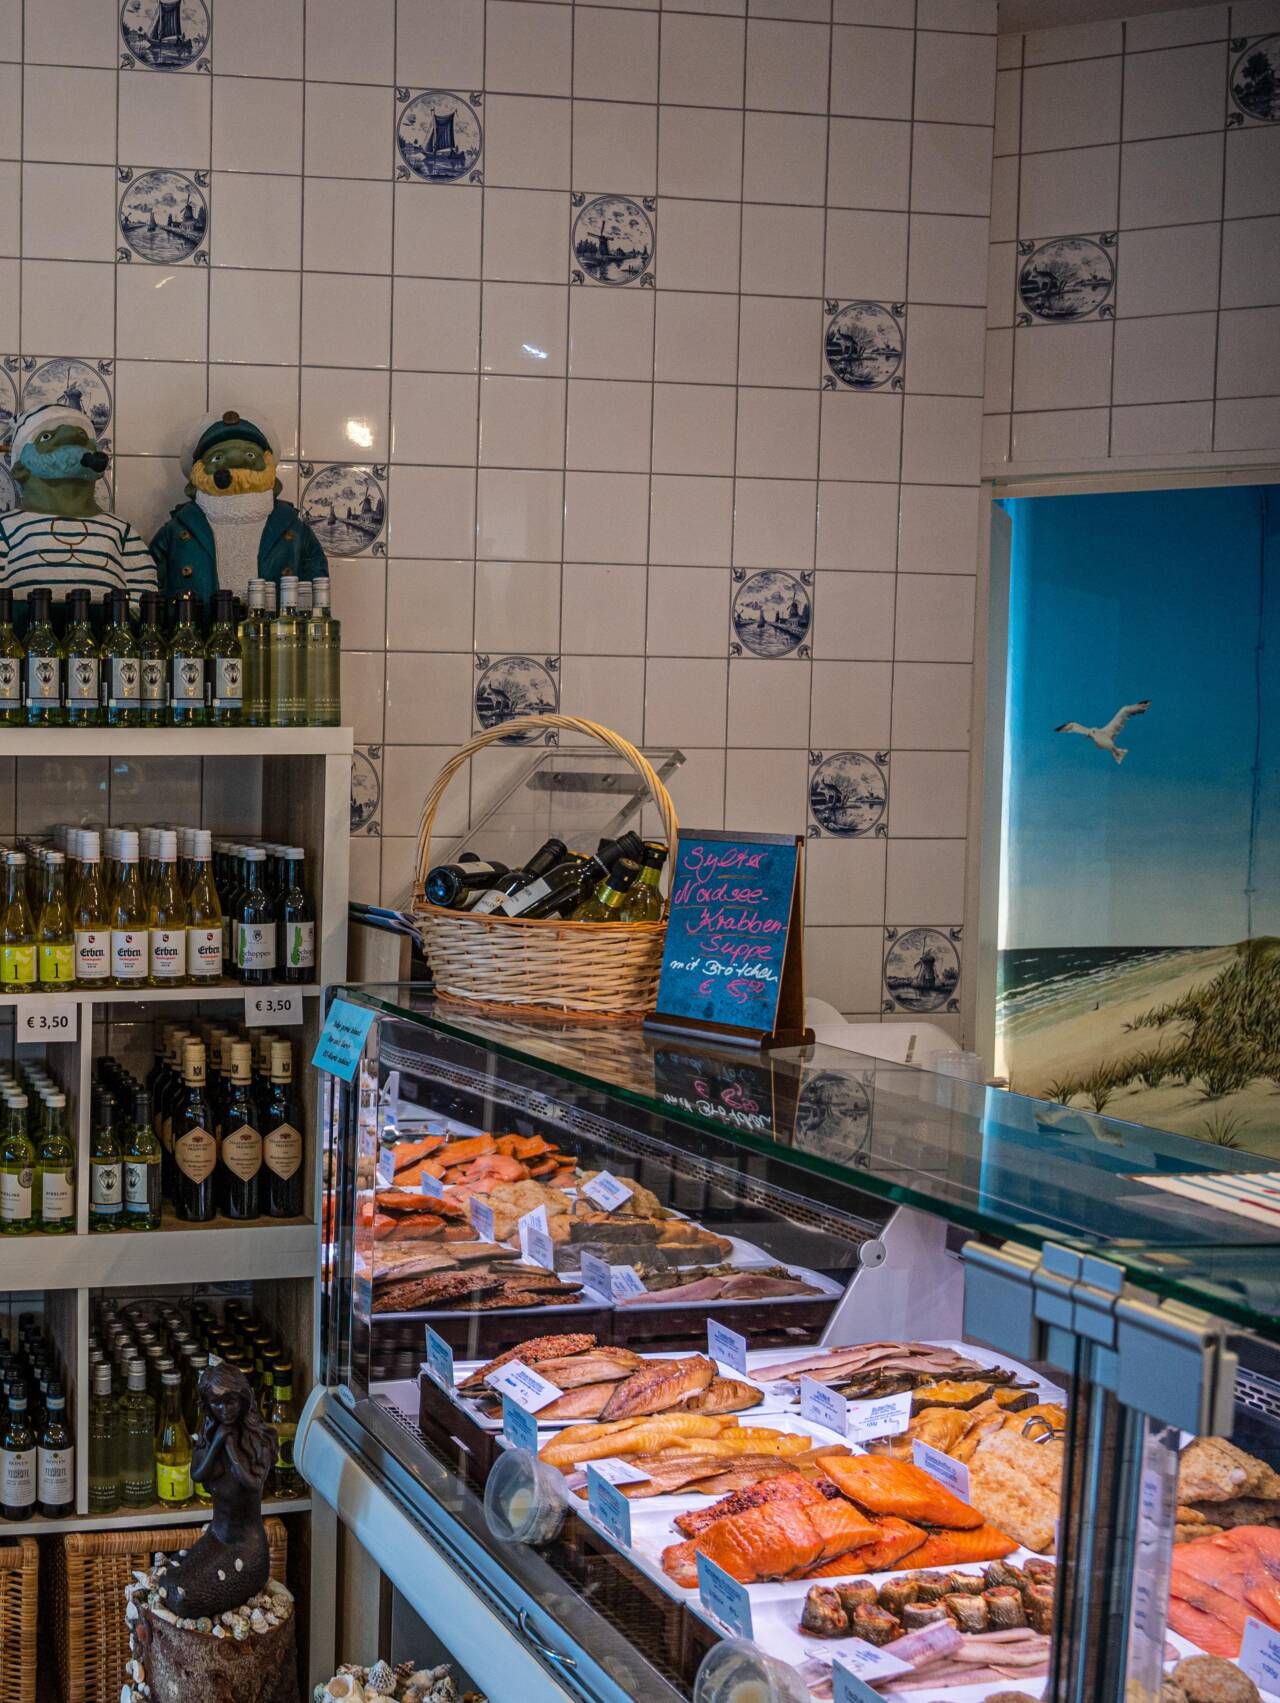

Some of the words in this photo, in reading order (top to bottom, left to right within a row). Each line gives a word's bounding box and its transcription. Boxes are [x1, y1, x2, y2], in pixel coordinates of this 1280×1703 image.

[686, 906, 789, 934] Krabben-
[80, 948, 104, 957] Erben
[117, 947, 141, 957] Erben
[154, 947, 178, 956] Erben
[198, 945, 220, 955] Erben
[700, 933, 774, 964] Suppe
[670, 957, 700, 971] mit
[702, 960, 779, 983] Brötchen
[699, 978, 715, 993] €
[255, 1001, 262, 1011] €
[266, 1000, 292, 1012] 3,50
[27, 1016, 35, 1029] €
[39, 1015, 69, 1030] 3,50
